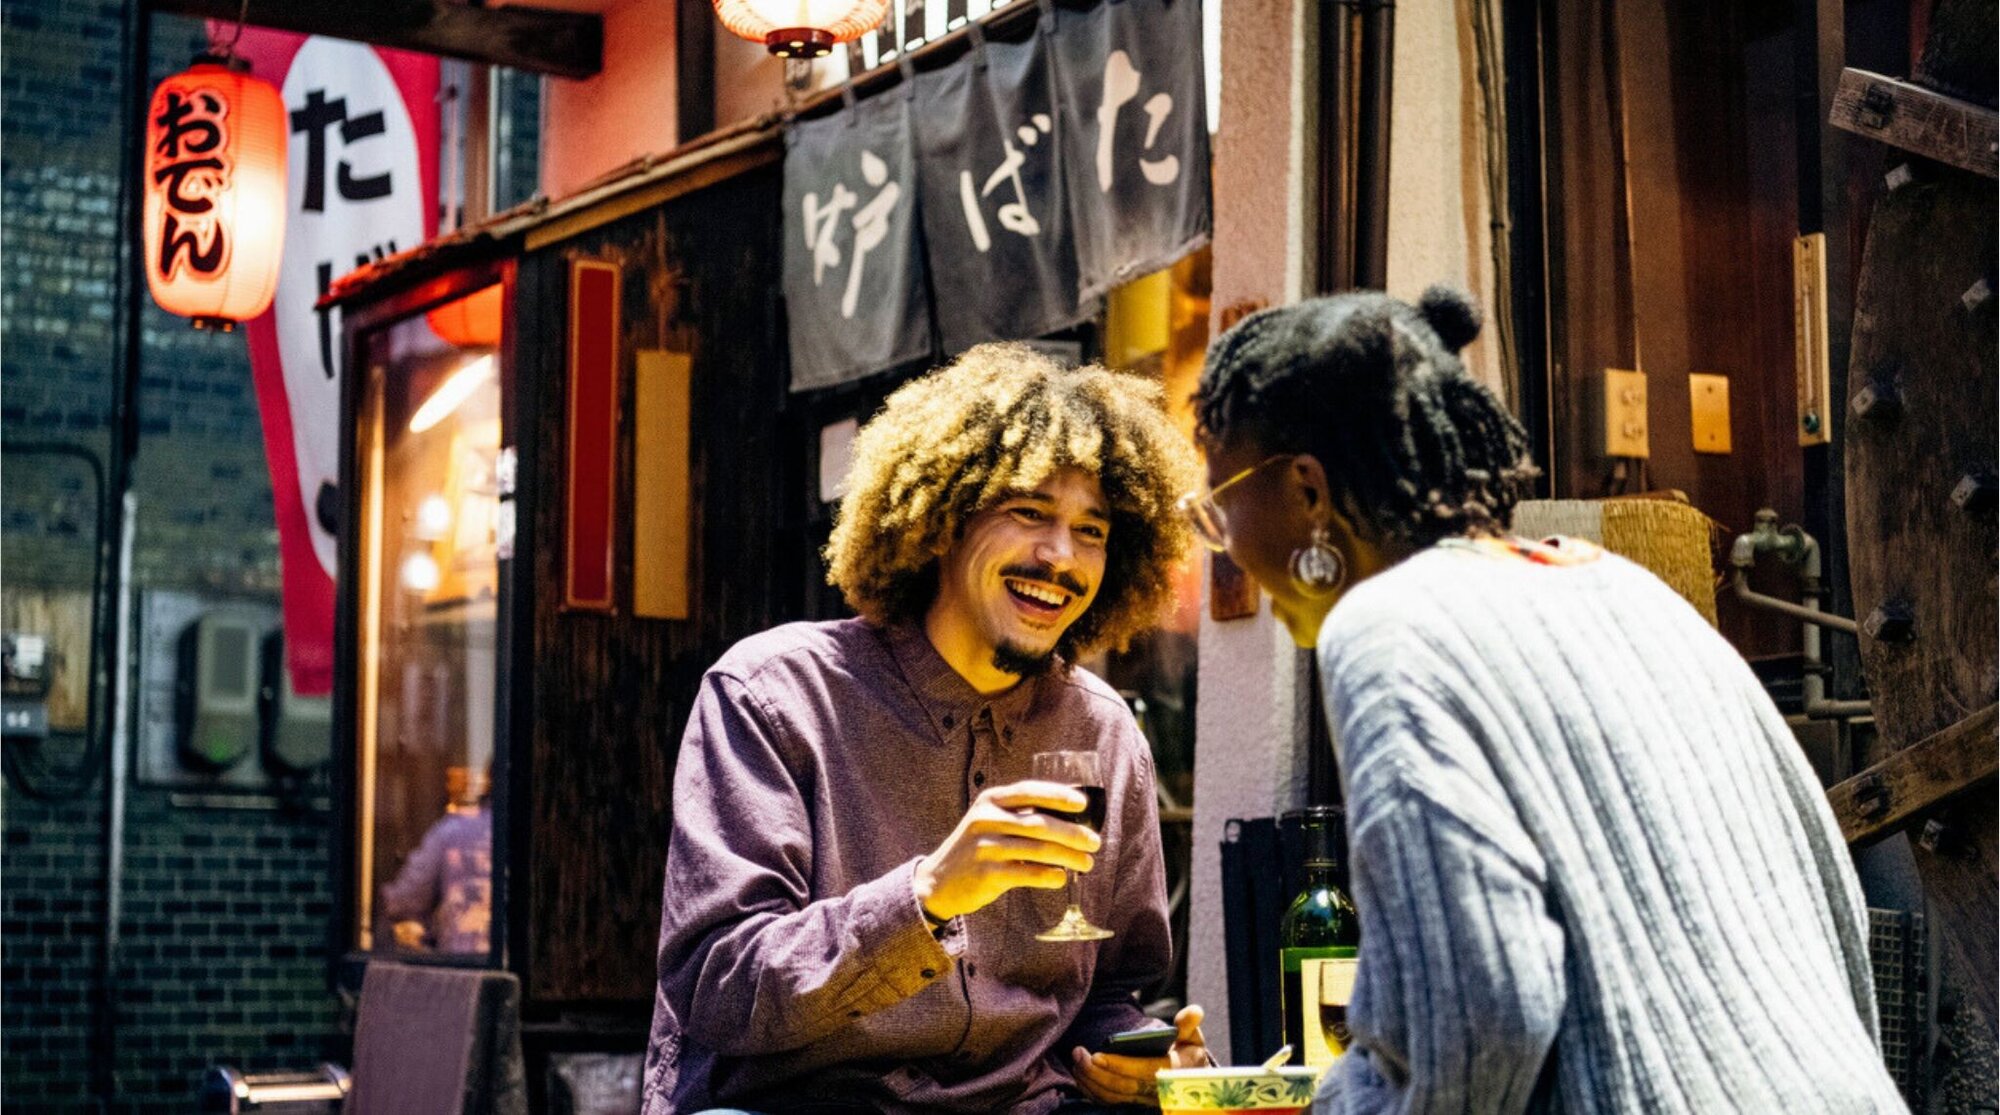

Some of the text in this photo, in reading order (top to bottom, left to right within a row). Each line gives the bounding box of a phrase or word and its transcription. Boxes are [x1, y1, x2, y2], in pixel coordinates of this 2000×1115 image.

[156, 94, 224, 277] おでん
[803, 50, 1180, 318] 炉ばた
